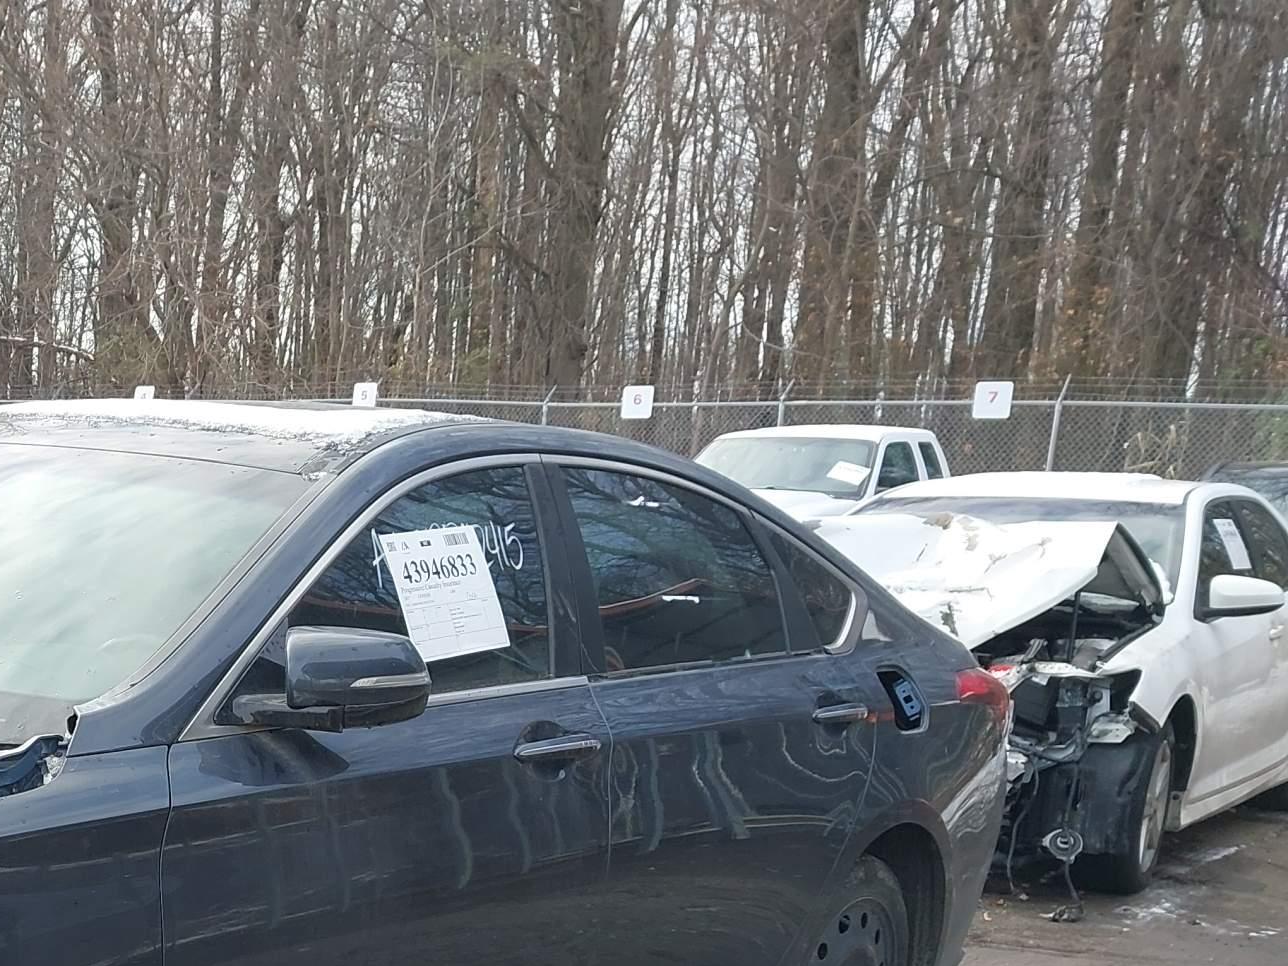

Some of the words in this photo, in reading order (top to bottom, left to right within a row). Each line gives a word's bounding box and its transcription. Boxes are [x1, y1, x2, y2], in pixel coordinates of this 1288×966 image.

[361, 390, 368, 400] 5
[633, 393, 642, 405] 6
[988, 391, 998, 403] 7
[402, 553, 477, 584] 43946833
